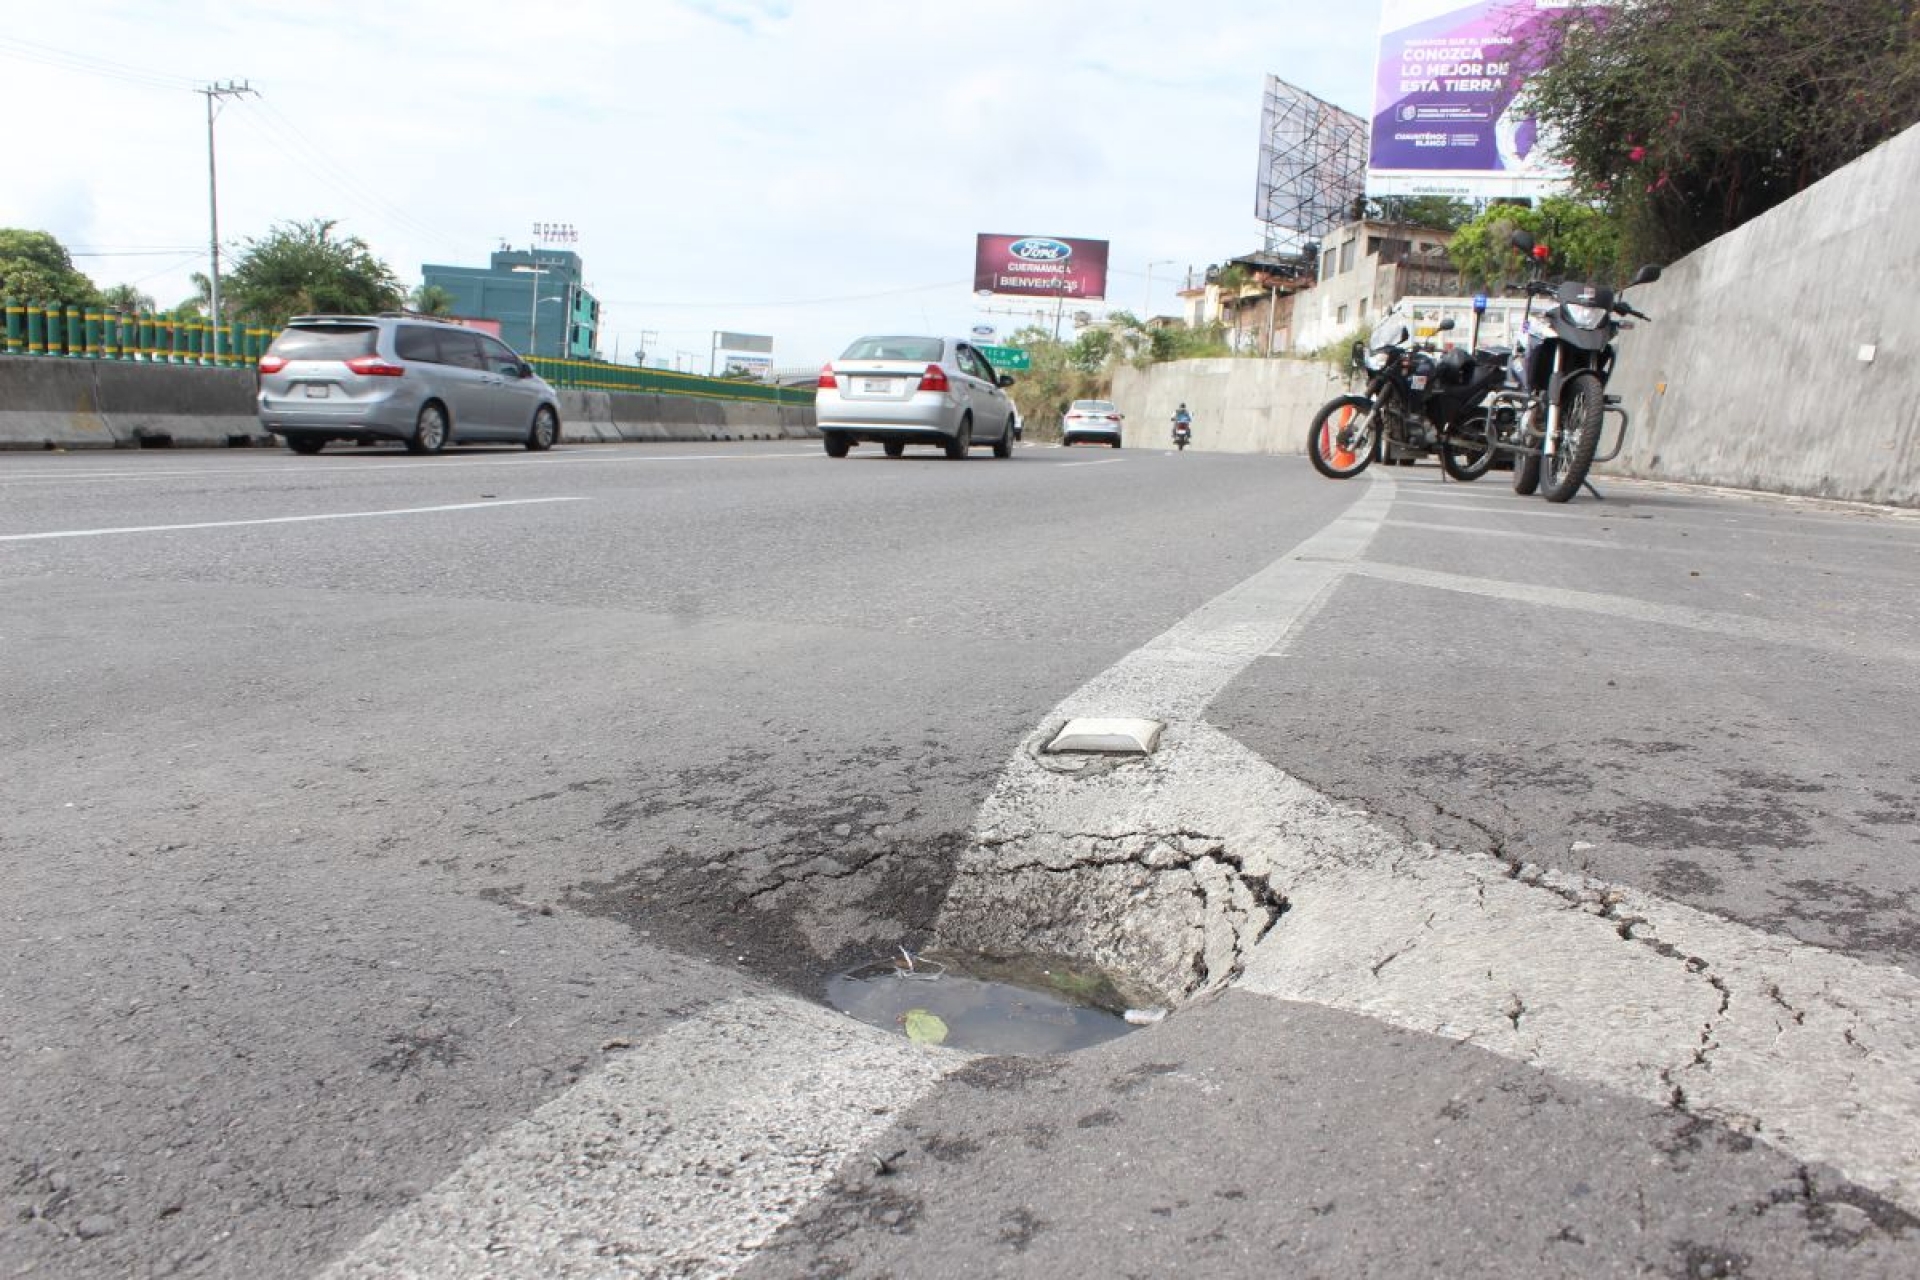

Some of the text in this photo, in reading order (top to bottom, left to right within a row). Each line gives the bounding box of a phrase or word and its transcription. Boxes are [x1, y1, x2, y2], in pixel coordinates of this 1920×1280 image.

[1402, 47, 1483, 60] CONOZCA
[1402, 61, 1509, 76] LO MEJOR DE
[1401, 79, 1502, 92] ESTA TIERRA
[1021, 242, 1059, 259] Ford
